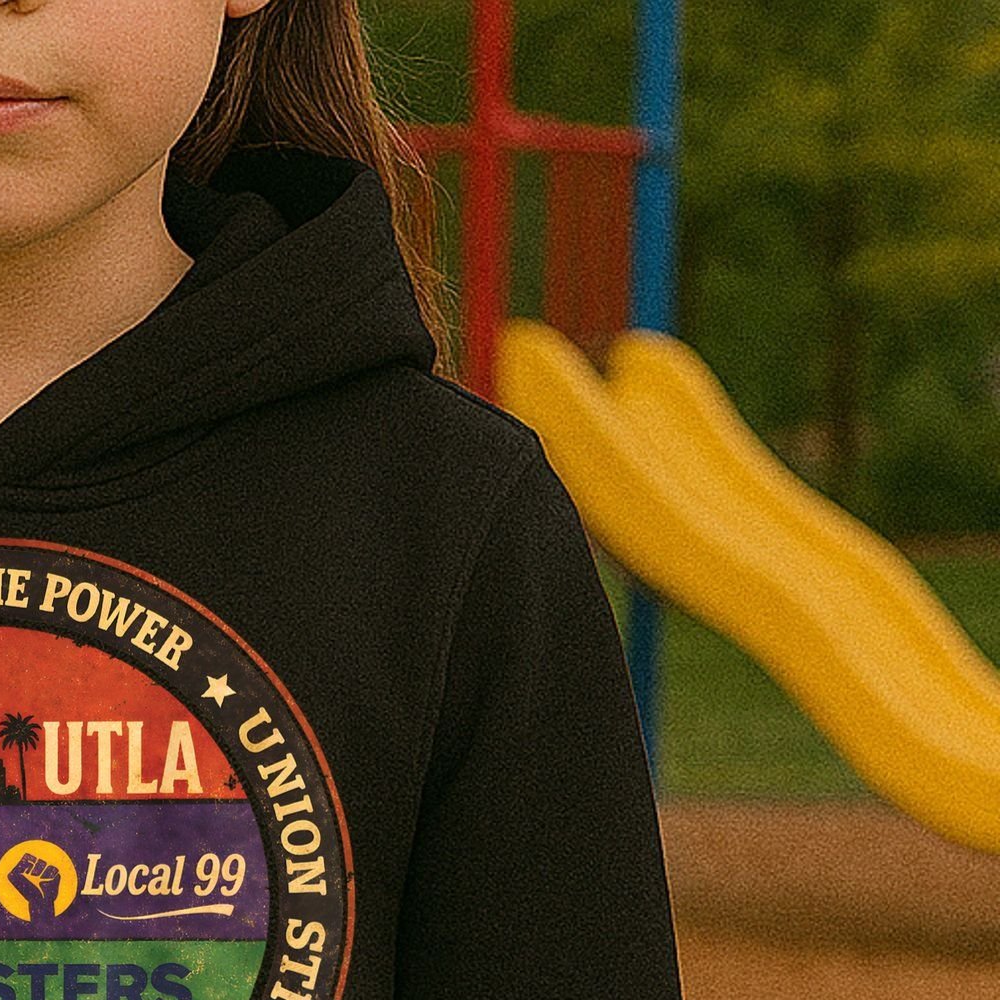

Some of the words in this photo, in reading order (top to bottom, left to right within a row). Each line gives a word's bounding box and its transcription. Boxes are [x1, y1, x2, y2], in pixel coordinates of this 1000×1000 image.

[39, 573, 194, 671] POWER
[43, 720, 203, 795] UTLA
[238, 707, 327, 896] UNION
[81, 853, 186, 896] Local
[194, 852, 246, 897] 99
